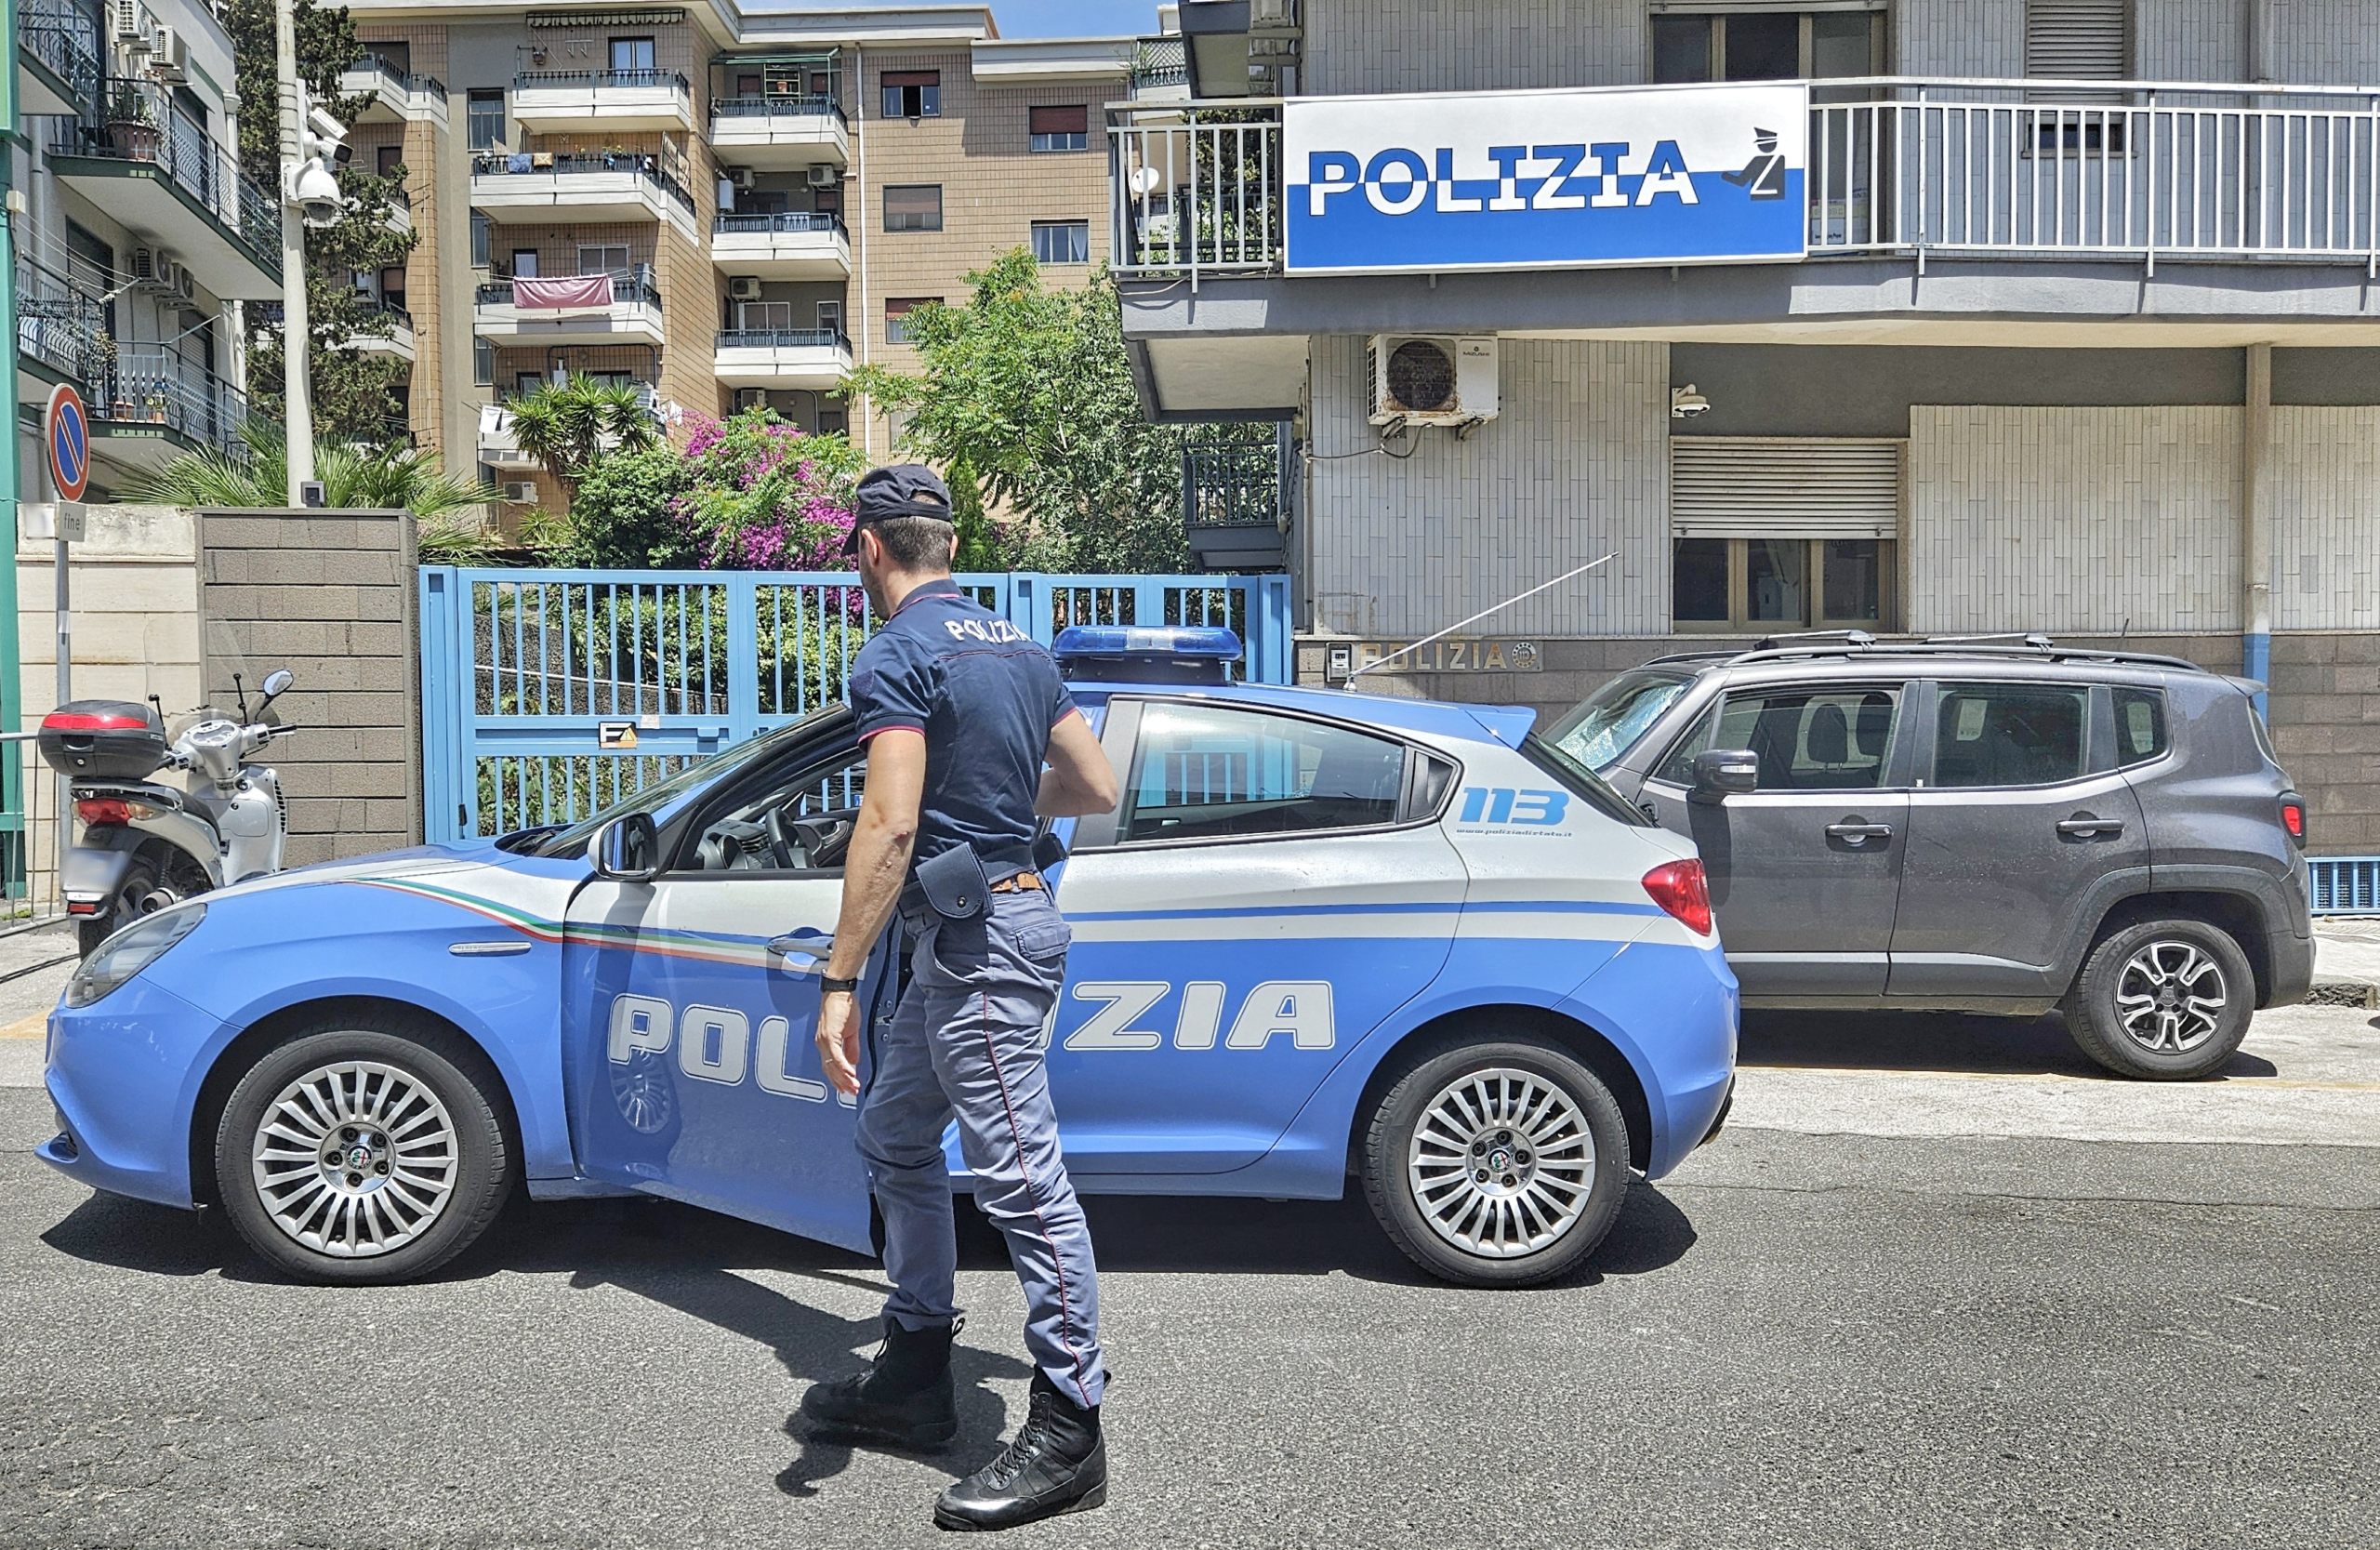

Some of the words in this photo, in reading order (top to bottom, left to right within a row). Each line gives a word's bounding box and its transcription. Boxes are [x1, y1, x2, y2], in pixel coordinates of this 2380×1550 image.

[1309, 139, 1699, 216] POLIZIA
[63, 512, 81, 531] fine
[944, 619, 1033, 643] POLIZIA
[1360, 643, 1507, 670] POLIZIA
[1519, 650, 1530, 660] 113
[1460, 787, 1569, 826] 113
